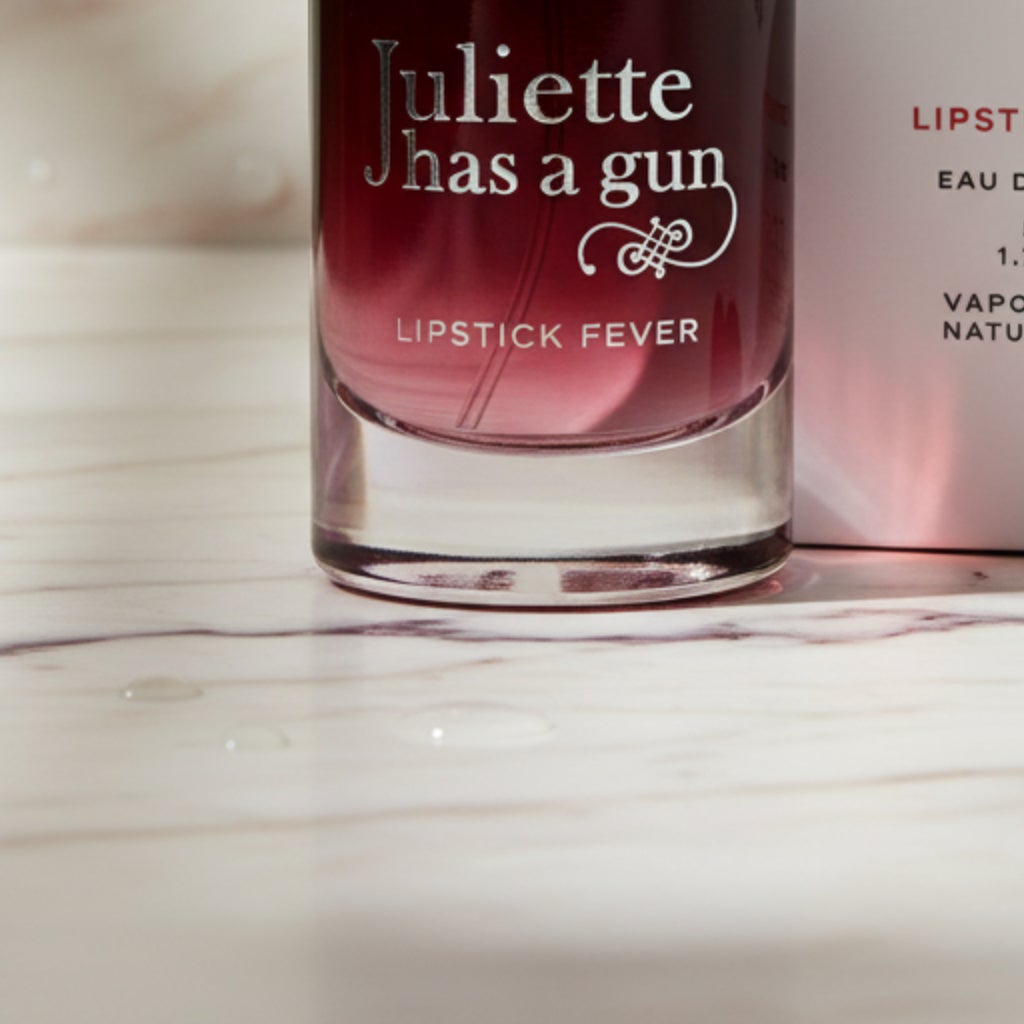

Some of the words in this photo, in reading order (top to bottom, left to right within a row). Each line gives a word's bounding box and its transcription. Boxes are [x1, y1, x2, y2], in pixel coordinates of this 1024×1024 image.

[364, 39, 693, 187] Juliette
[402, 129, 519, 195] has
[540, 153, 580, 196] a
[937, 170, 998, 191] EAU
[397, 317, 563, 349] LIPSTICK
[581, 317, 699, 349] FEVER
